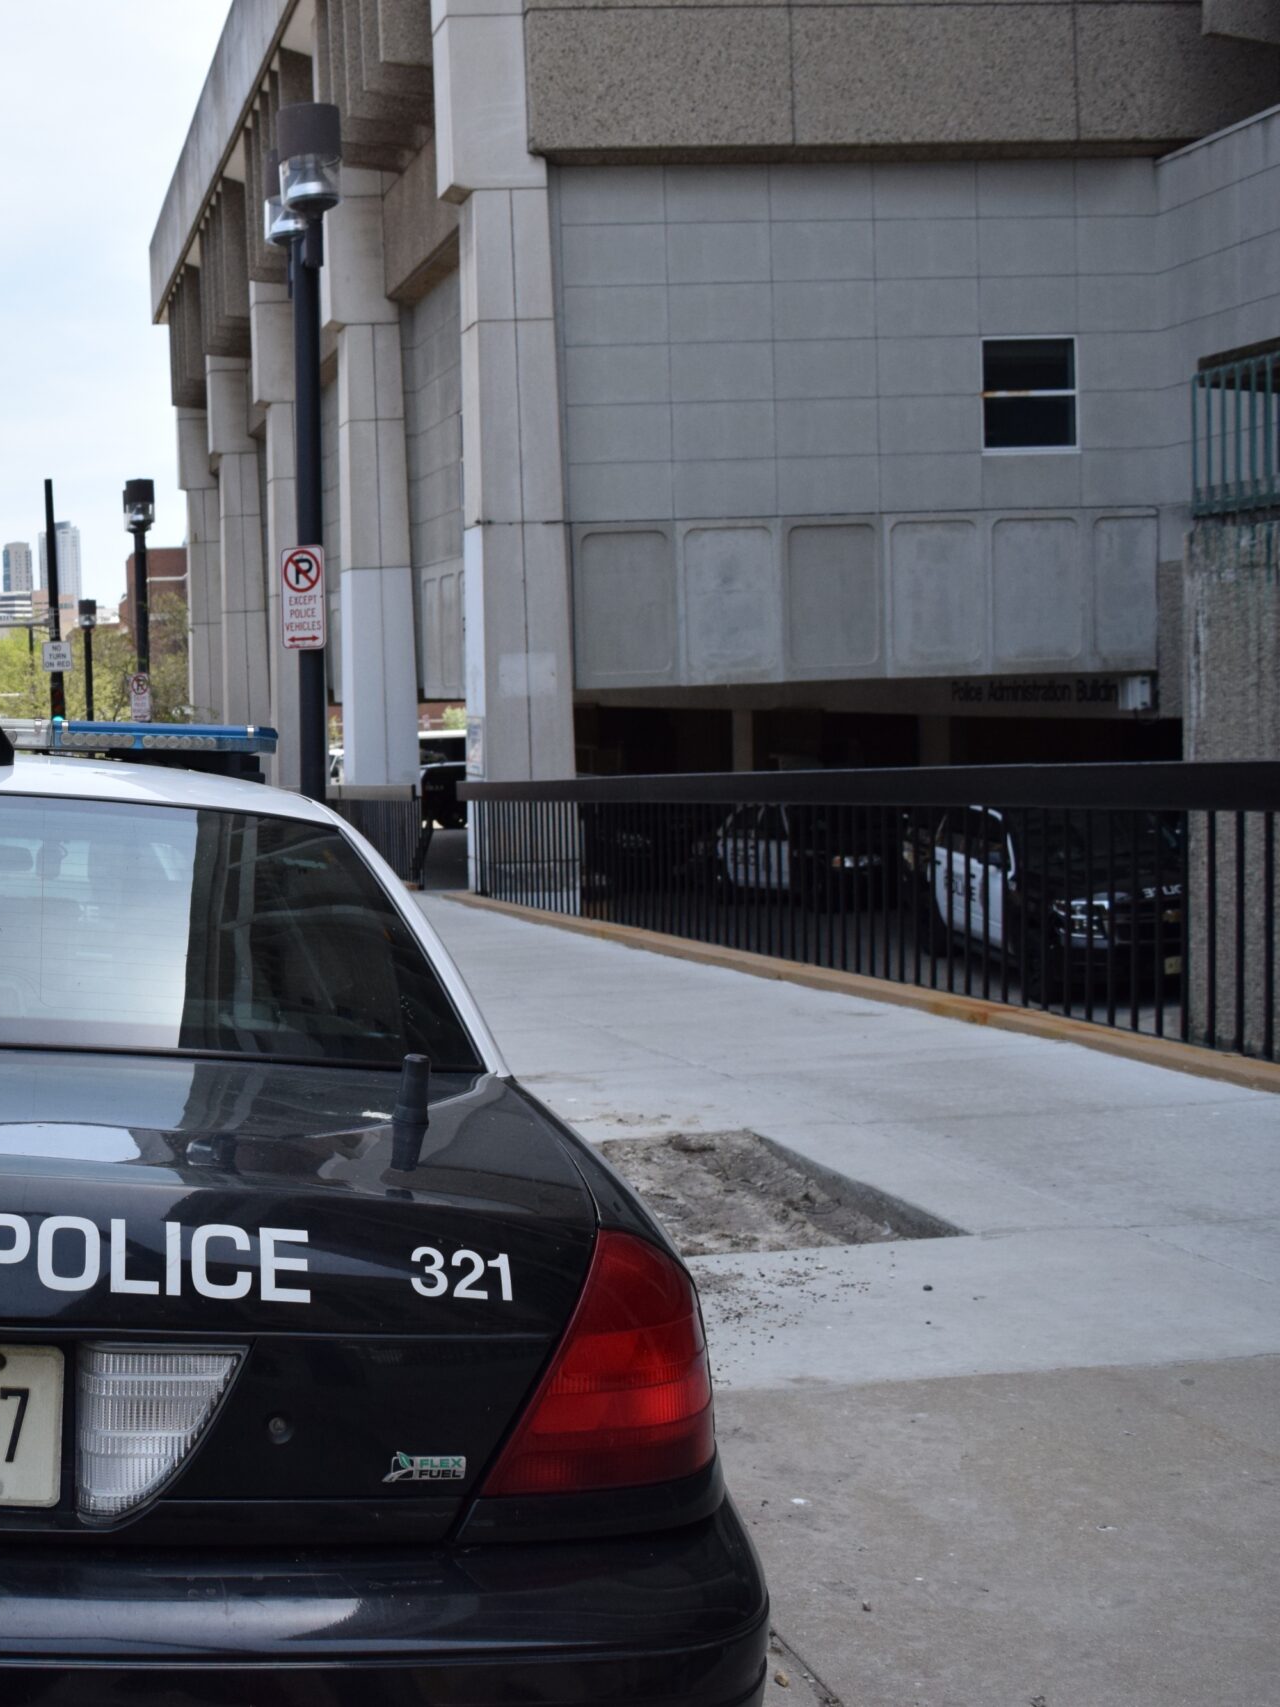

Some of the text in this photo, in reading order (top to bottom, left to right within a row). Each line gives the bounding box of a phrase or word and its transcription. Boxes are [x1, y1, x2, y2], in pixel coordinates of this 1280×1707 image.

[288, 595, 317, 606] EXCEPT
[289, 608, 316, 619] POLICE
[285, 621, 321, 632] VEHICLES
[951, 679, 1119, 702] Police Administration Buildin
[410, 1246, 513, 1301] 321
[419, 1458, 462, 1469] FLEX
[418, 1469, 462, 1479] FUEL
